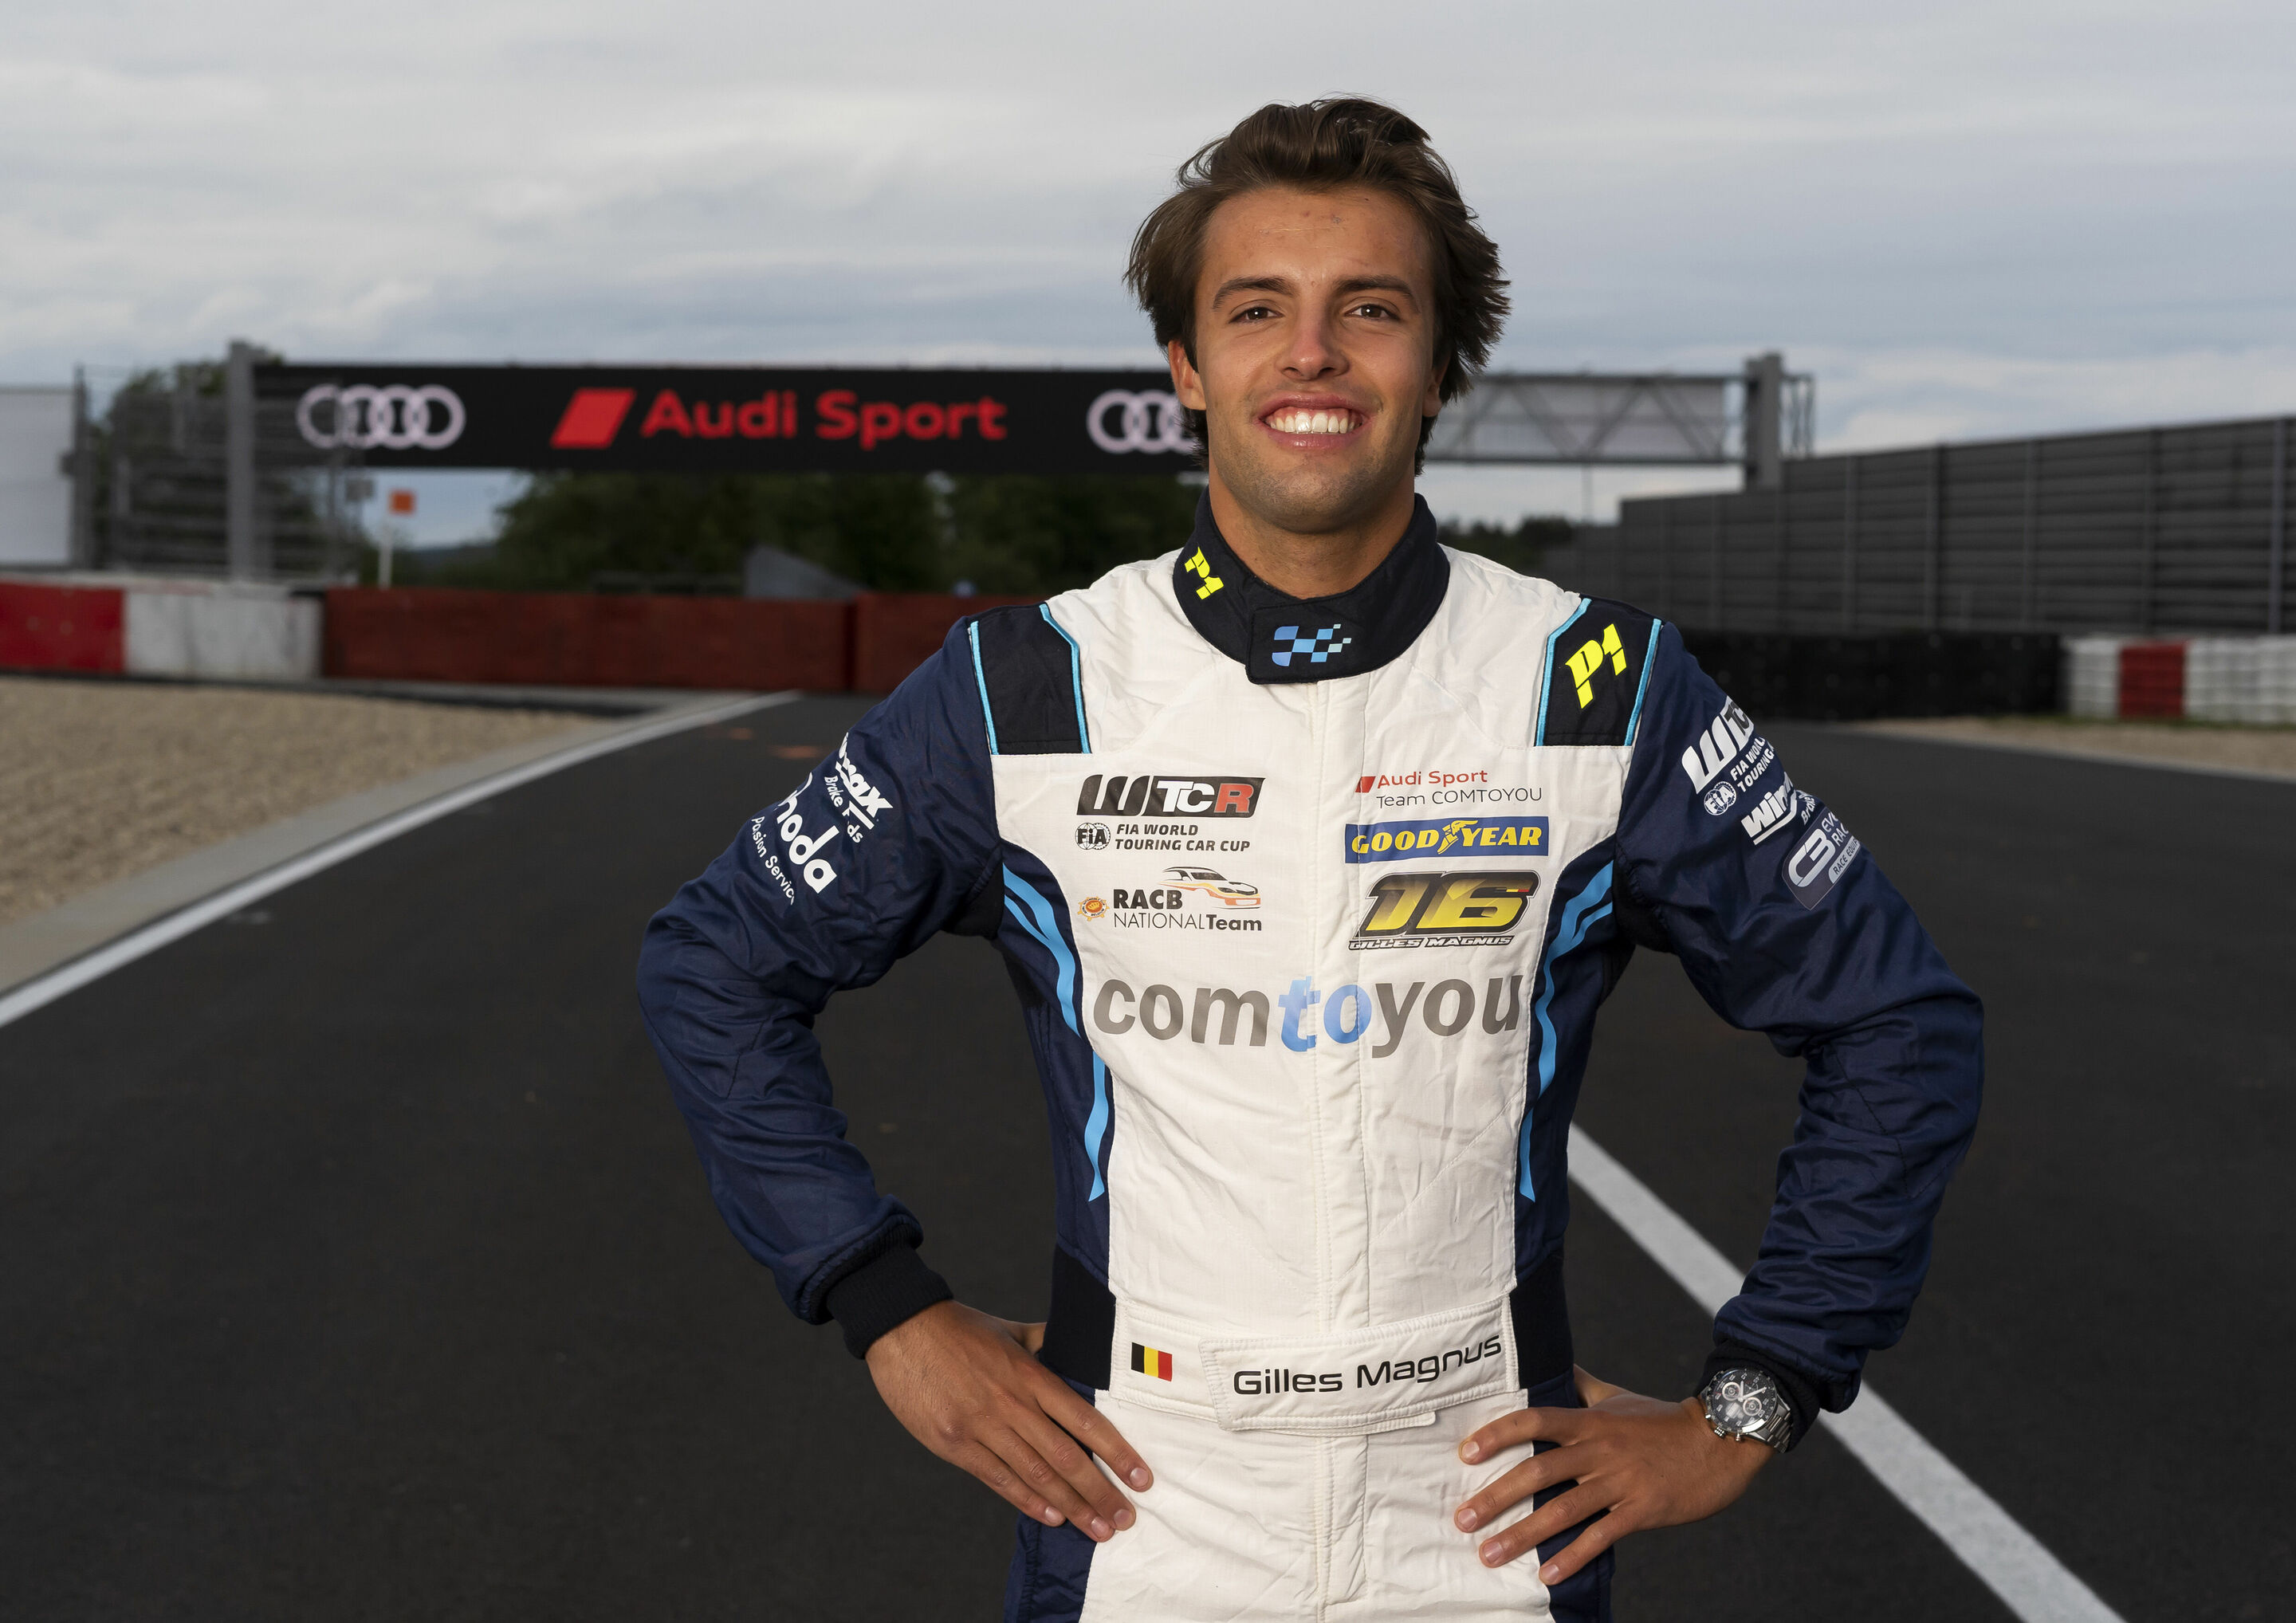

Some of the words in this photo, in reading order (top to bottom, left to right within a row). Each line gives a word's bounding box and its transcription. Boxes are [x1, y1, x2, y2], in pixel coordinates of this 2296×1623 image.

[641, 389, 796, 438] Audi
[816, 389, 1008, 450] Sport
[1565, 623, 1627, 709] P1
[1682, 696, 1754, 794] WTC
[1377, 772, 1421, 788] Audi
[1429, 770, 1488, 787] Sport
[1730, 760, 1750, 781] FIA
[824, 776, 843, 807] Brake
[1076, 774, 1266, 818] WTCR
[1376, 795, 1425, 808] Team
[1432, 788, 1543, 805] COMTOYOU
[1116, 823, 1139, 835] FIA
[1144, 824, 1199, 836] WORLD
[1115, 839, 1181, 851] TOURING
[1185, 840, 1216, 851] CAR
[1220, 840, 1251, 851] CUP
[1833, 855, 1848, 875] RACE
[1113, 889, 1183, 910] RACB
[1360, 875, 1537, 933] 16
[1350, 938, 1422, 950] GILLES
[1425, 936, 1513, 948] MAGNUS
[1093, 975, 1523, 1059] comtoyou
[1233, 1368, 1343, 1395] Gilles
[1357, 1334, 1502, 1389] Magnus
